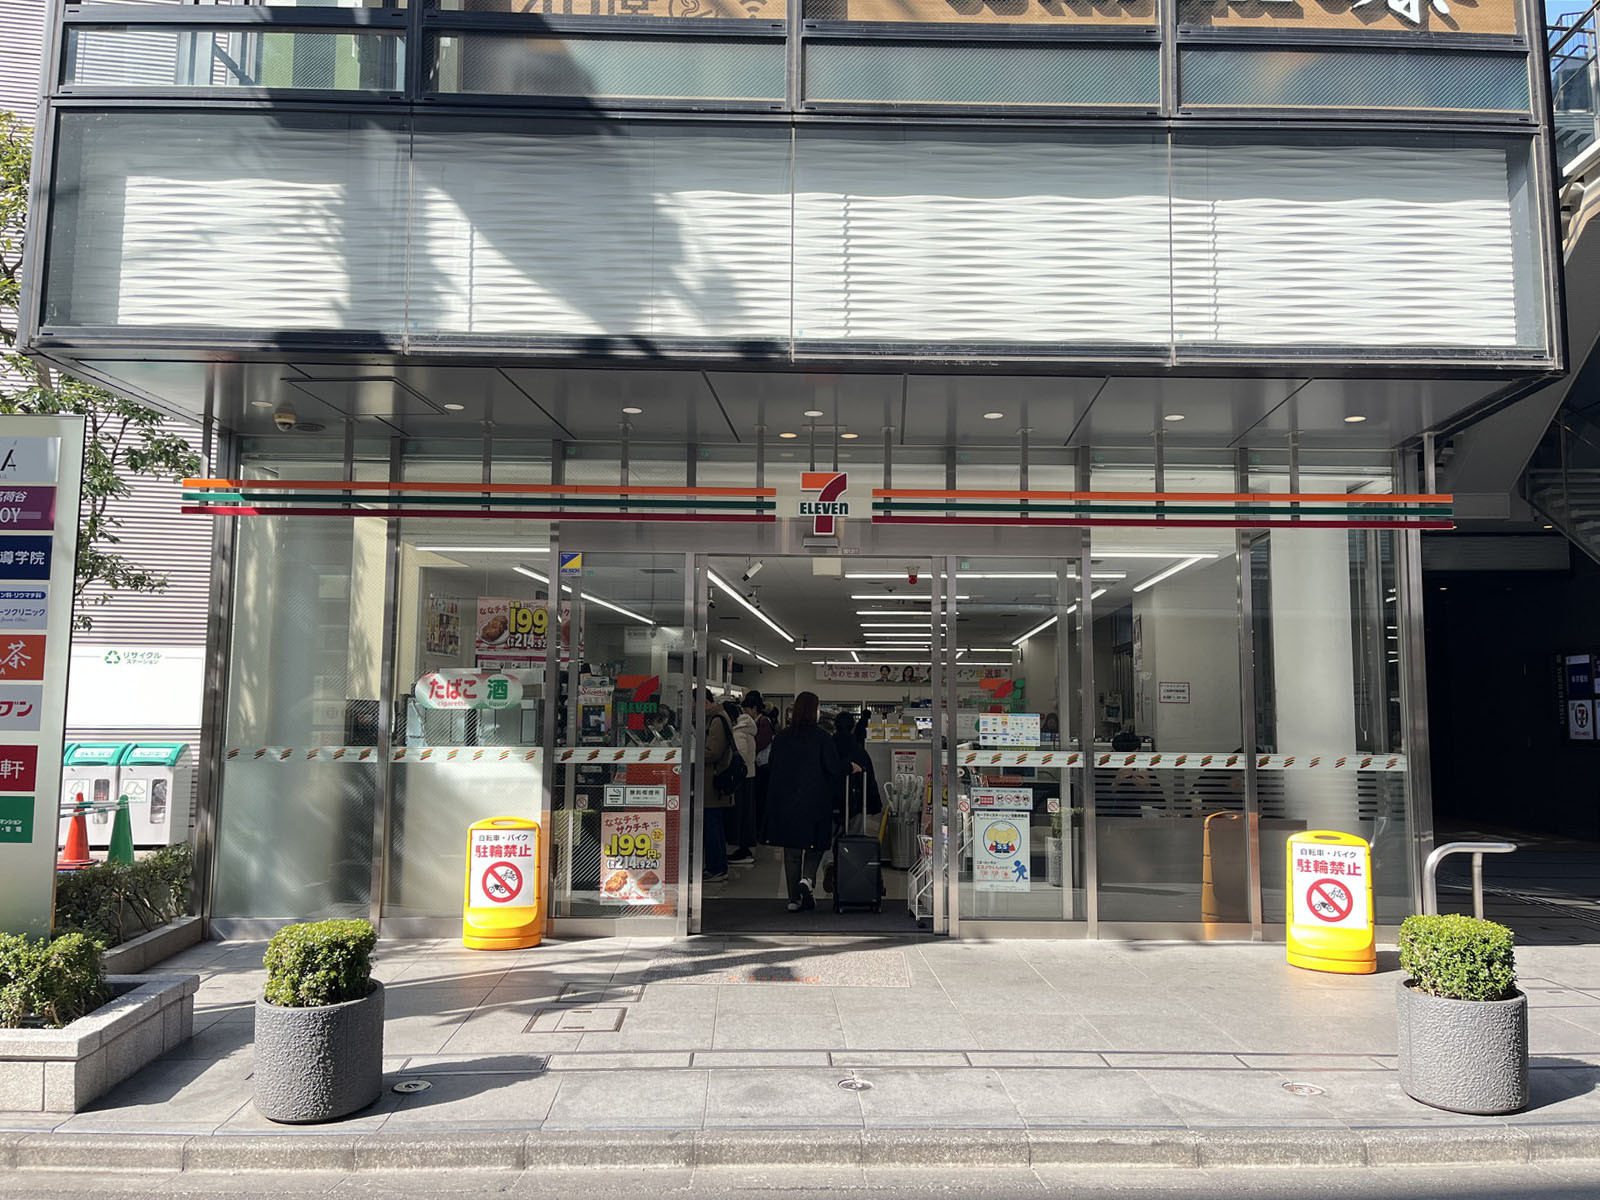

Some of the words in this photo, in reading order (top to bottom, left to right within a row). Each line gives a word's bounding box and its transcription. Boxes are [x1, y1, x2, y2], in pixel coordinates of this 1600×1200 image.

[123, 652, 162, 660] リサイクル
[429, 678, 478, 700] たばこ
[487, 679, 509, 700] 酒
[0, 759, 24, 779] 軒
[604, 814, 641, 828] ななチキ
[475, 844, 532, 858] 駐輪禁止
[1296, 858, 1363, 877] 駐輪禁止
